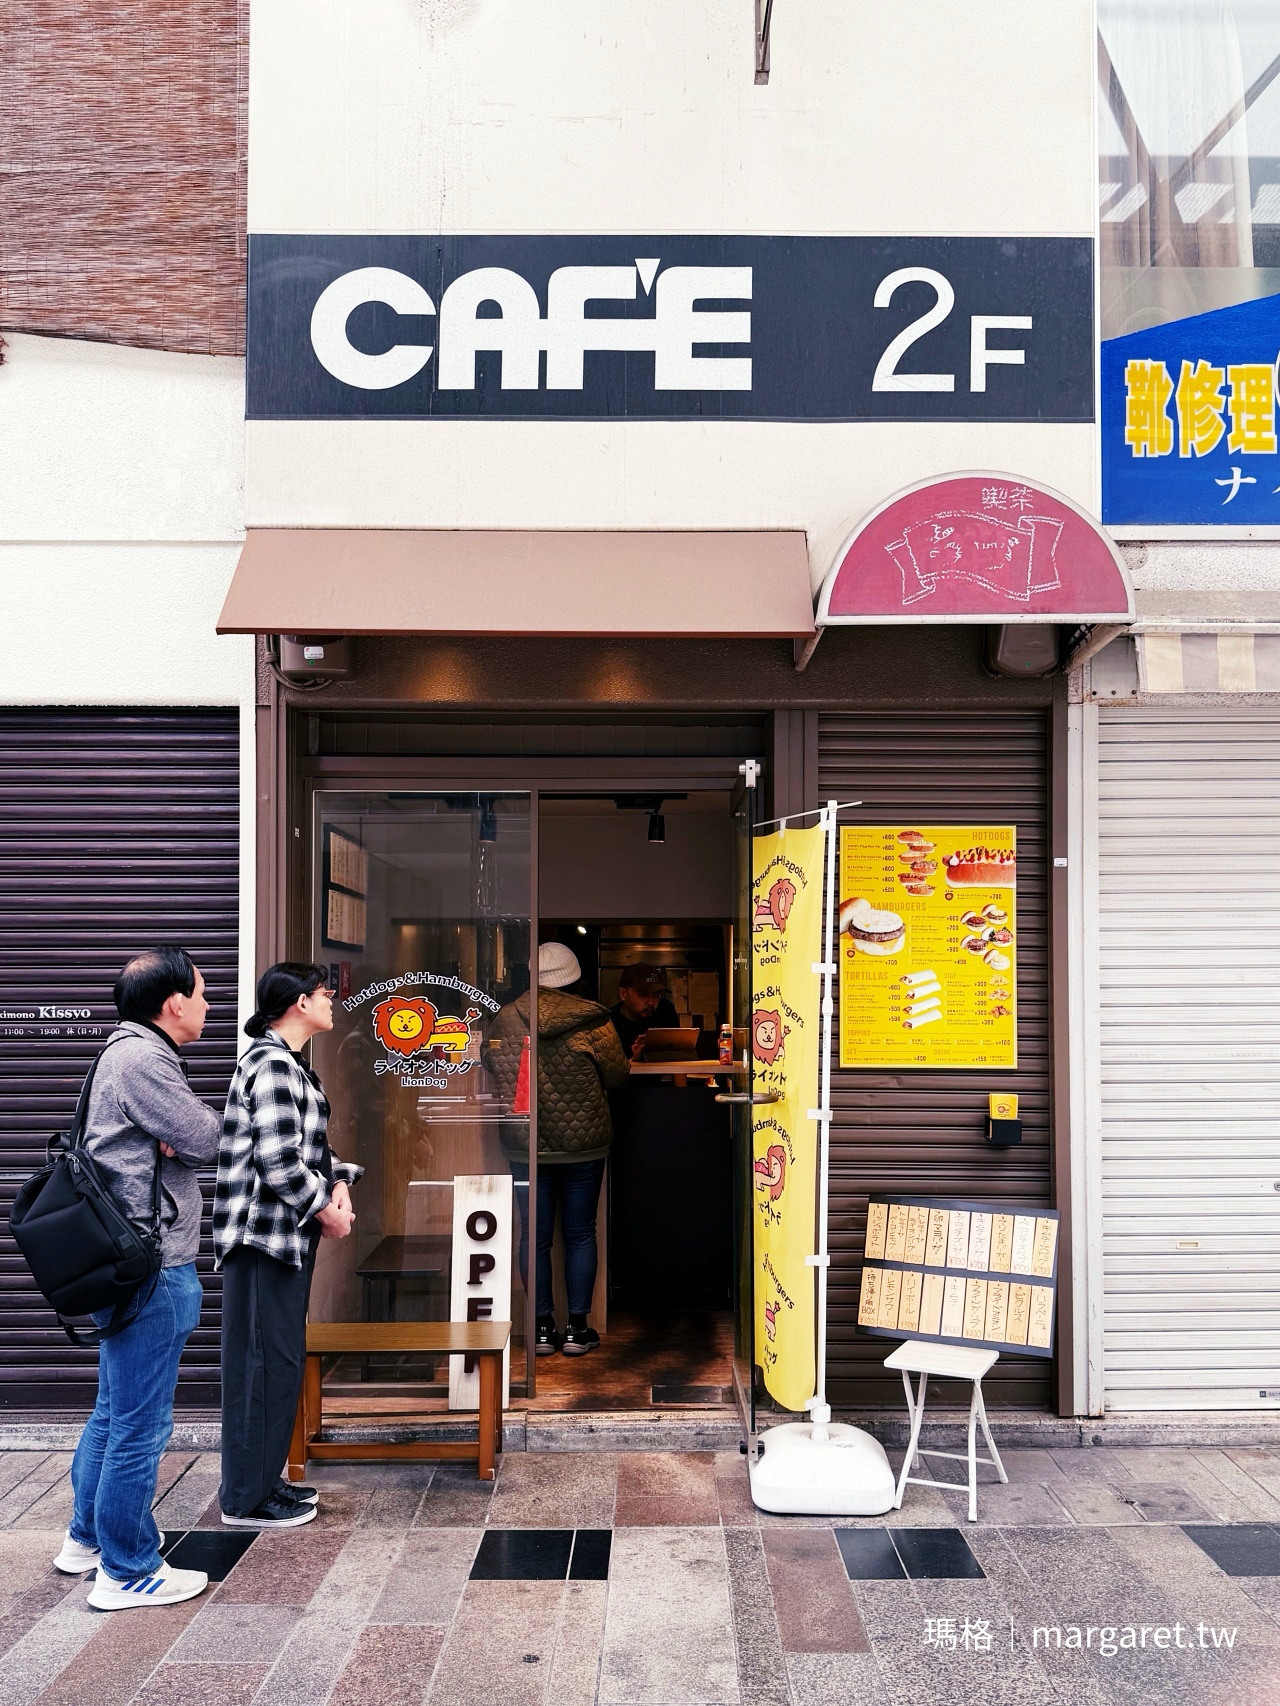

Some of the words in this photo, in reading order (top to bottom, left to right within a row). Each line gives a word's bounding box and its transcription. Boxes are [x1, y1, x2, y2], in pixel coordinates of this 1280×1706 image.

[871, 266, 1033, 393] 2F
[1124, 358, 1278, 458] 靴修理
[981, 486, 1034, 511] 喫茶
[972, 831, 1011, 841] HOTDOGS
[870, 902, 927, 911] HAMBURGERS
[845, 972, 889, 981] TORTILLAS
[38, 1005, 91, 1020] Kissyo
[374, 1059, 474, 1075] ライオンドッグ
[401, 1076, 448, 1089] LionDog
[464, 1210, 498, 1374] OPE
[1013, 1291, 1026, 1323] ピクルス
